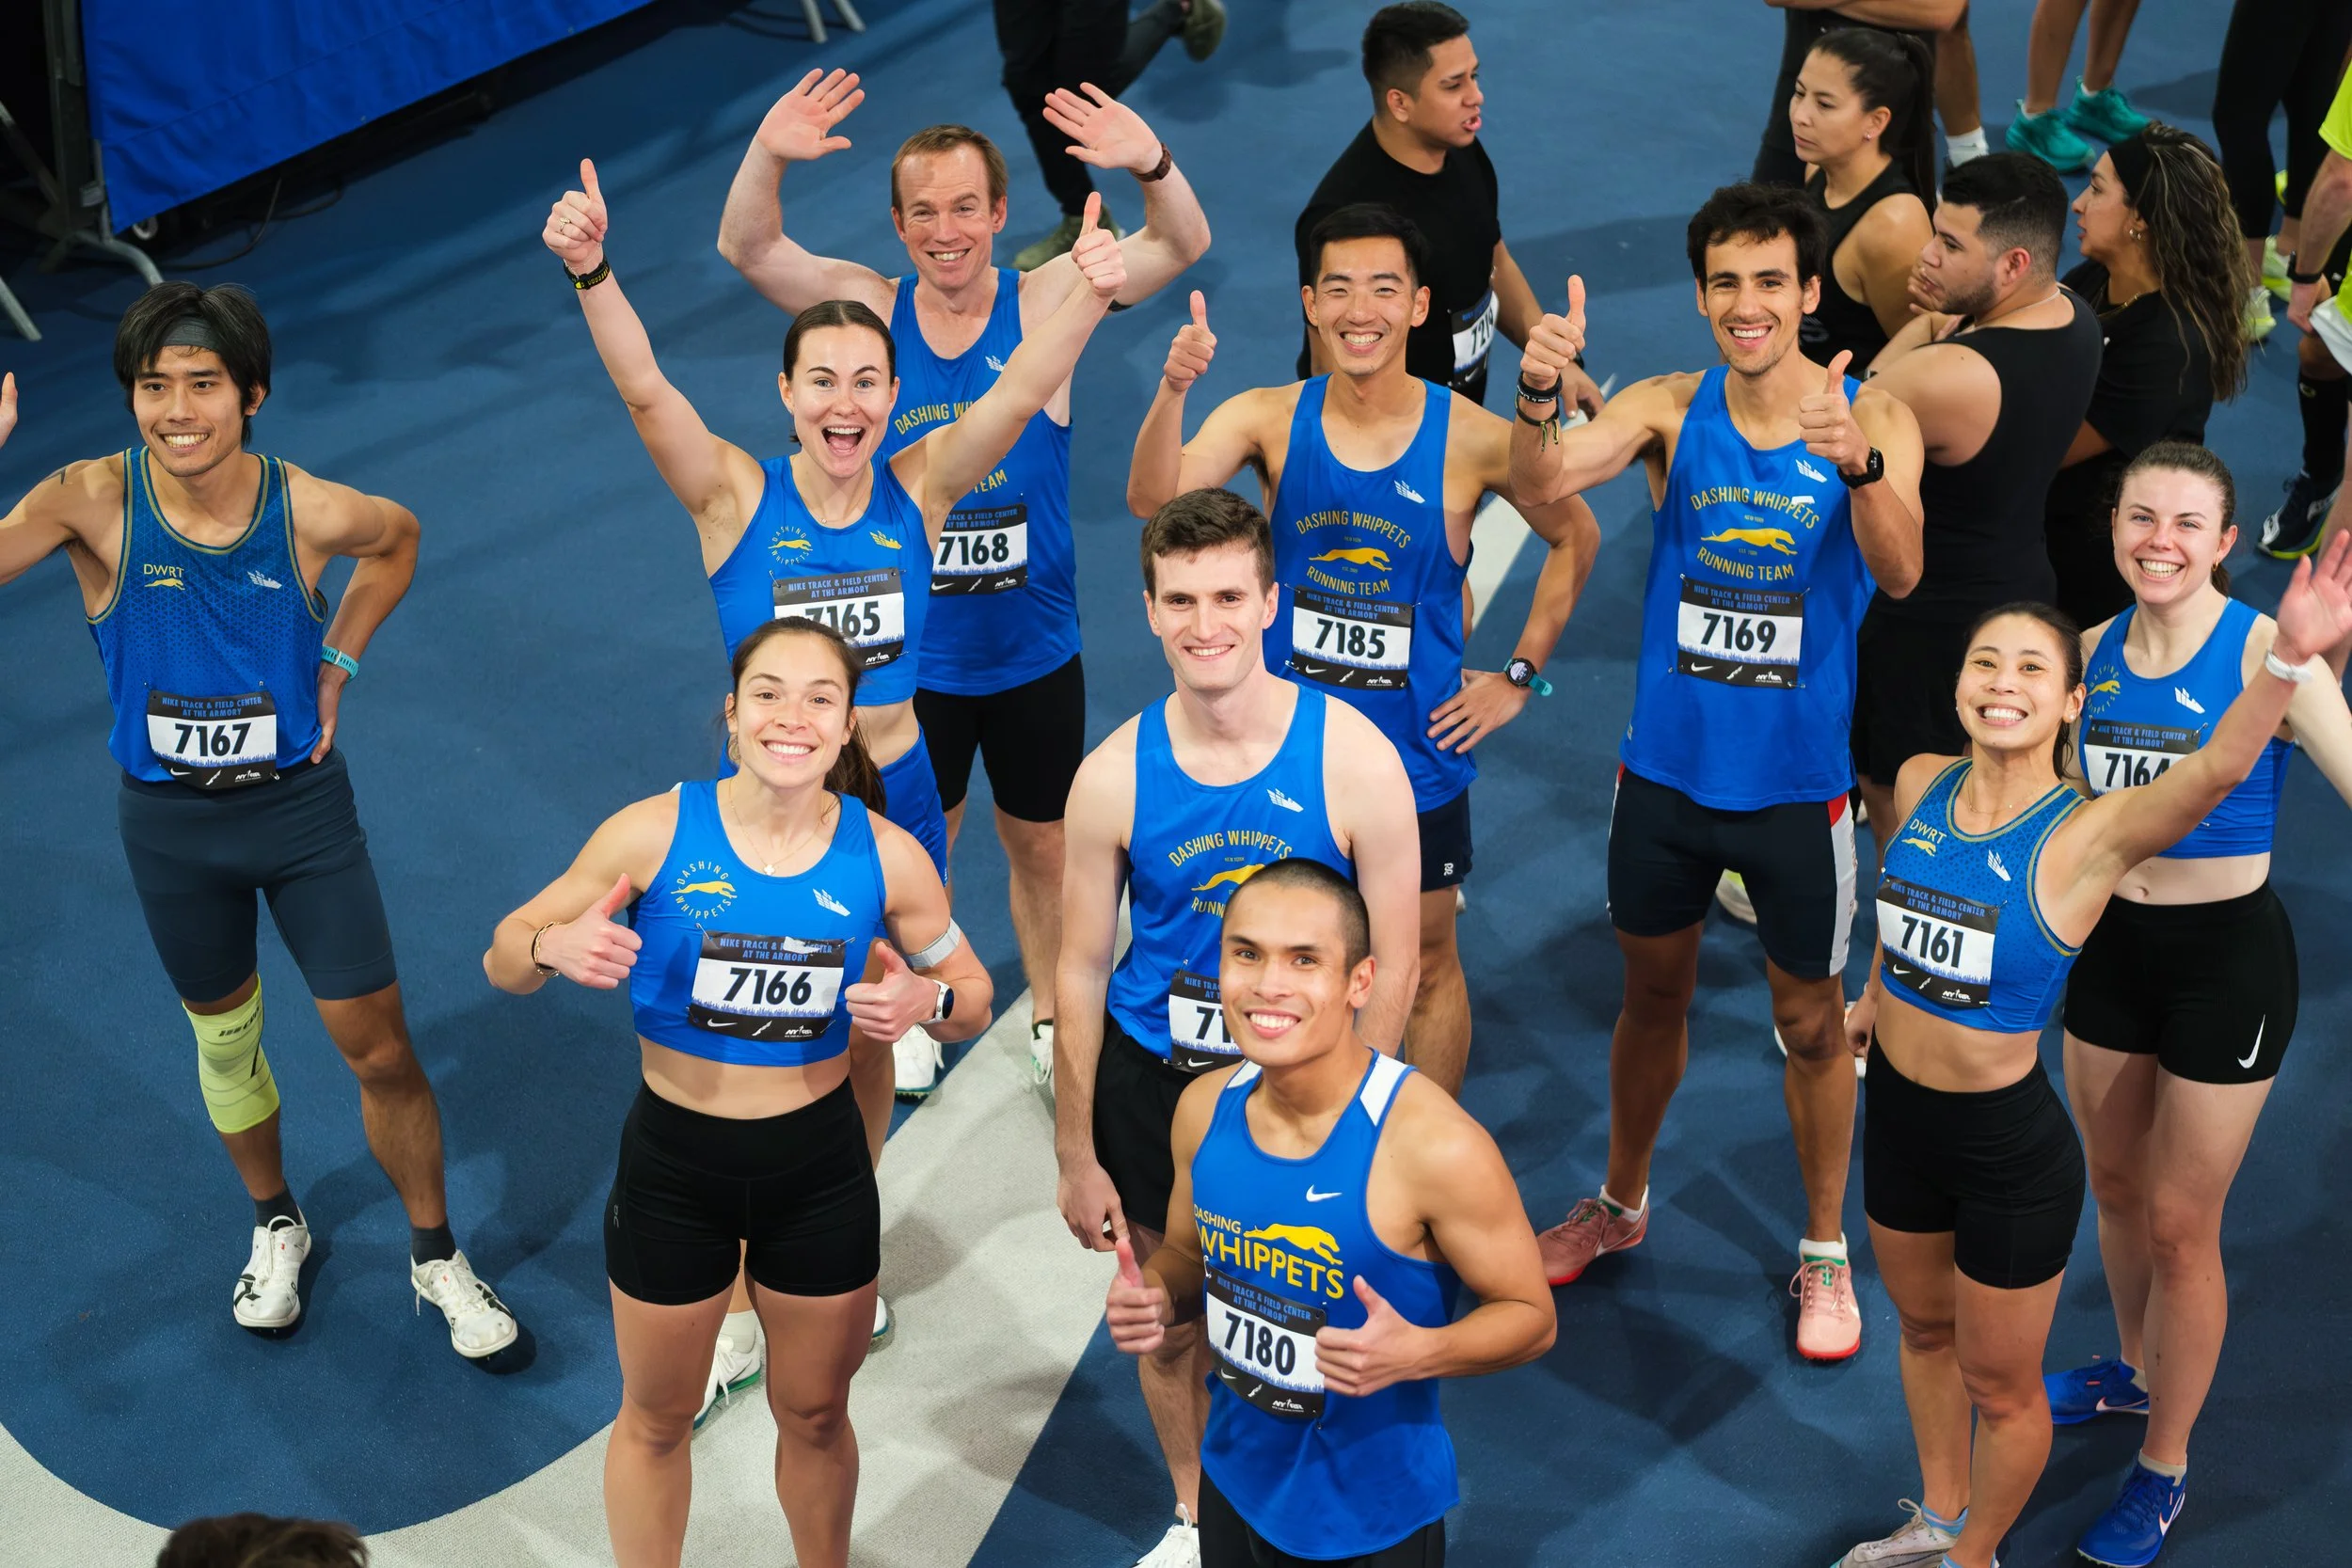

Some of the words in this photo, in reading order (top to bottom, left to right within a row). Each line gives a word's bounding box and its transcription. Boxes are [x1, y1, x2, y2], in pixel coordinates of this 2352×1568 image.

[894, 403, 950, 436] DASHING
[947, 513, 965, 521] RACK
[975, 511, 993, 520] FIELD
[994, 509, 1018, 518] CENTER
[1690, 486, 1750, 511] DASHING
[1753, 490, 1820, 530] WHIPPETS
[771, 526, 806, 542] DASHING
[946, 520, 955, 529] AT
[956, 520, 968, 529] THE
[970, 519, 1000, 528] ARMORY
[1295, 510, 1349, 534] DASHING
[1352, 511, 1411, 548] WHIPPETS
[771, 549, 809, 565] WHIPPETS
[938, 532, 1009, 565] 7168
[144, 563, 184, 578] DWRT
[1696, 546, 1754, 579] RUNNING
[1757, 563, 1795, 581] TEAM
[788, 581, 806, 592] NIKE
[808, 579, 832, 590] TRACK
[842, 577, 862, 586] FIELD
[864, 573, 889, 583] CENTER
[811, 590, 820, 598] AT
[822, 589, 835, 597] THE
[837, 585, 869, 595] ARMORY
[1307, 565, 1355, 594] RUNNING
[1359, 578, 1391, 595] TEAM
[1307, 593, 1322, 603] NIKE
[1323, 595, 1343, 607] TRACK
[1346, 600, 1351, 609] &
[1354, 601, 1372, 610] FIELD
[1375, 603, 1399, 614] CENTER
[1693, 585, 1709, 596] NIKE
[1710, 588, 1731, 600] TRACK
[1734, 593, 1740, 601] &
[1742, 593, 1761, 602] FIELD
[1764, 594, 1790, 605] CENTER
[1711, 596, 1721, 606] AT
[1723, 598, 1734, 609] THE
[1736, 600, 1769, 611] ARMORY
[805, 600, 881, 639] 7165
[1324, 603, 1333, 612] AT
[1334, 606, 1346, 615] THE
[1347, 609, 1378, 620] ARMORY
[1314, 617, 1386, 659] 7185
[1701, 612, 1776, 654] 7169
[162, 697, 179, 707] NIKE
[181, 700, 203, 708] TRACK
[215, 699, 234, 708] FIELD
[236, 696, 262, 706] CENTER
[194, 709, 206, 718] THE
[209, 707, 242, 718] ARMORY
[175, 722, 251, 757] 7167
[2098, 725, 2110, 735] NIKE
[2111, 725, 2132, 736] TRACK
[2134, 728, 2139, 736] &
[2141, 729, 2159, 738] FIELD
[2161, 731, 2186, 741] CENTER
[2112, 736, 2122, 744] AT
[2122, 736, 2134, 746] THE
[2135, 737, 2166, 749] ARMORY
[1909, 817, 1947, 845] DWRT
[1168, 832, 1224, 867] DASHING
[1227, 830, 1293, 860] WHIPPETS
[676, 860, 729, 885] DASHING
[675, 895, 733, 919] WHIPPETS
[1191, 895, 1226, 919] RUNN
[1890, 882, 1905, 895] NIKE
[1907, 887, 1929, 901] TRACK
[1931, 895, 1937, 904] &
[1938, 896, 1957, 909] FIELD
[1959, 902, 1985, 917] CENTER
[1907, 898, 1916, 908] AT
[1917, 900, 1931, 911] THE
[1931, 906, 1963, 921] ARMORY
[720, 938, 739, 947] NIKE
[742, 940, 768, 950] TRACK
[771, 942, 777, 950] &
[1901, 914, 1964, 969] 7161
[742, 950, 752, 958] AT
[755, 951, 770, 959] THE
[772, 952, 808, 962] ARMORY
[723, 967, 812, 1006] 7166
[1184, 976, 1201, 988] NIKE
[1202, 980, 1220, 990] TRA
[1205, 990, 1214, 999] AT
[1196, 1006, 1232, 1043] 71
[1193, 1203, 1241, 1234] DASHING
[1195, 1219, 1344, 1300] WHIPPETS
[1216, 1275, 1232, 1290] NIKE
[1232, 1282, 1255, 1299] TRACK
[1256, 1291, 1263, 1302] &
[1263, 1293, 1281, 1310] FIELD
[1283, 1306, 1311, 1321] CENTER
[1233, 1295, 1243, 1306] AT
[1244, 1298, 1257, 1310] THE
[1258, 1304, 1288, 1324] ARMORY
[1224, 1310, 1296, 1376] 7180
